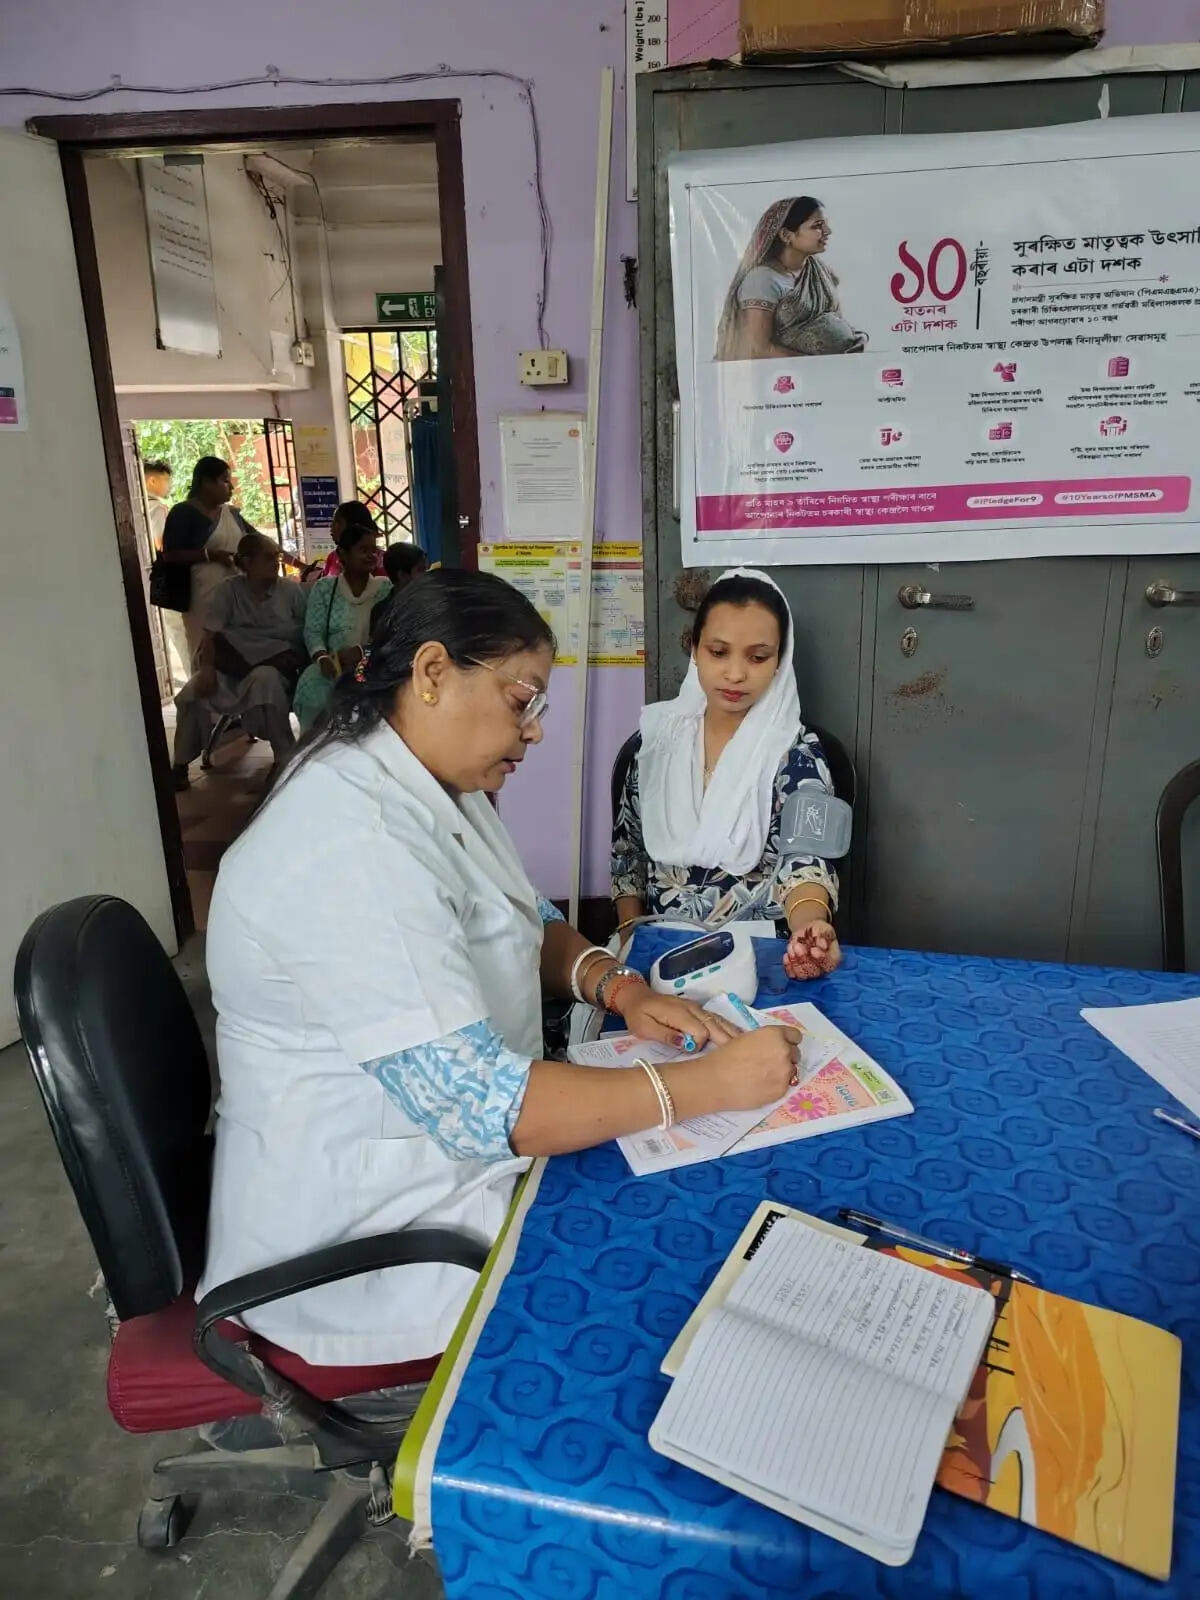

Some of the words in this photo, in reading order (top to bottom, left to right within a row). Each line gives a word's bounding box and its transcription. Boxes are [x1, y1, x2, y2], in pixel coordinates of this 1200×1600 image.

[648, 15, 660, 23] 200
[635, 29, 645, 62] Weight
[648, 38, 660, 46] 180
[1013, 234, 1076, 258] সুৰক্ষিত
[1081, 233, 1145, 252] মাতৃত্বক
[1148, 226, 1200, 245] উৎসা
[890, 237, 967, 304] ১০
[1012, 260, 1058, 277] কৰাৰ
[1064, 256, 1094, 274] এটা
[1100, 255, 1143, 272] দশক
[424, 307, 436, 318] EX
[904, 304, 946, 316] যতনৰ
[891, 320, 917, 332] এটা
[923, 318, 958, 330] দশক
[902, 344, 944, 354] আপোনাৰ
[946, 341, 983, 352] নিকটতম
